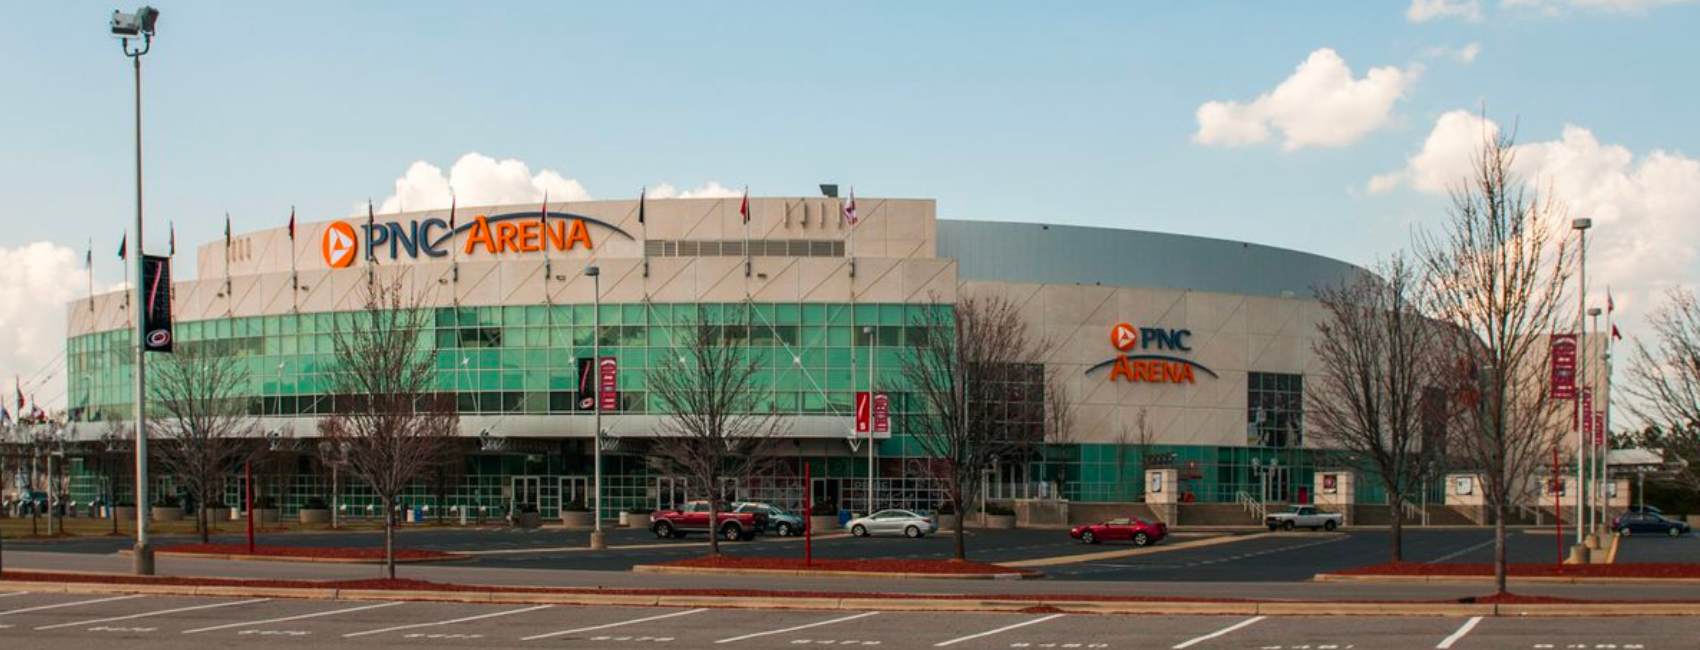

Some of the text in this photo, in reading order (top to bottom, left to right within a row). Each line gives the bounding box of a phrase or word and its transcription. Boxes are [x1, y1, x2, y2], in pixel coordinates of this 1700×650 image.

[361, 215, 593, 260] PNC ARENA
[1139, 327, 1192, 351] PNC
[1110, 354, 1196, 384] ARENA
